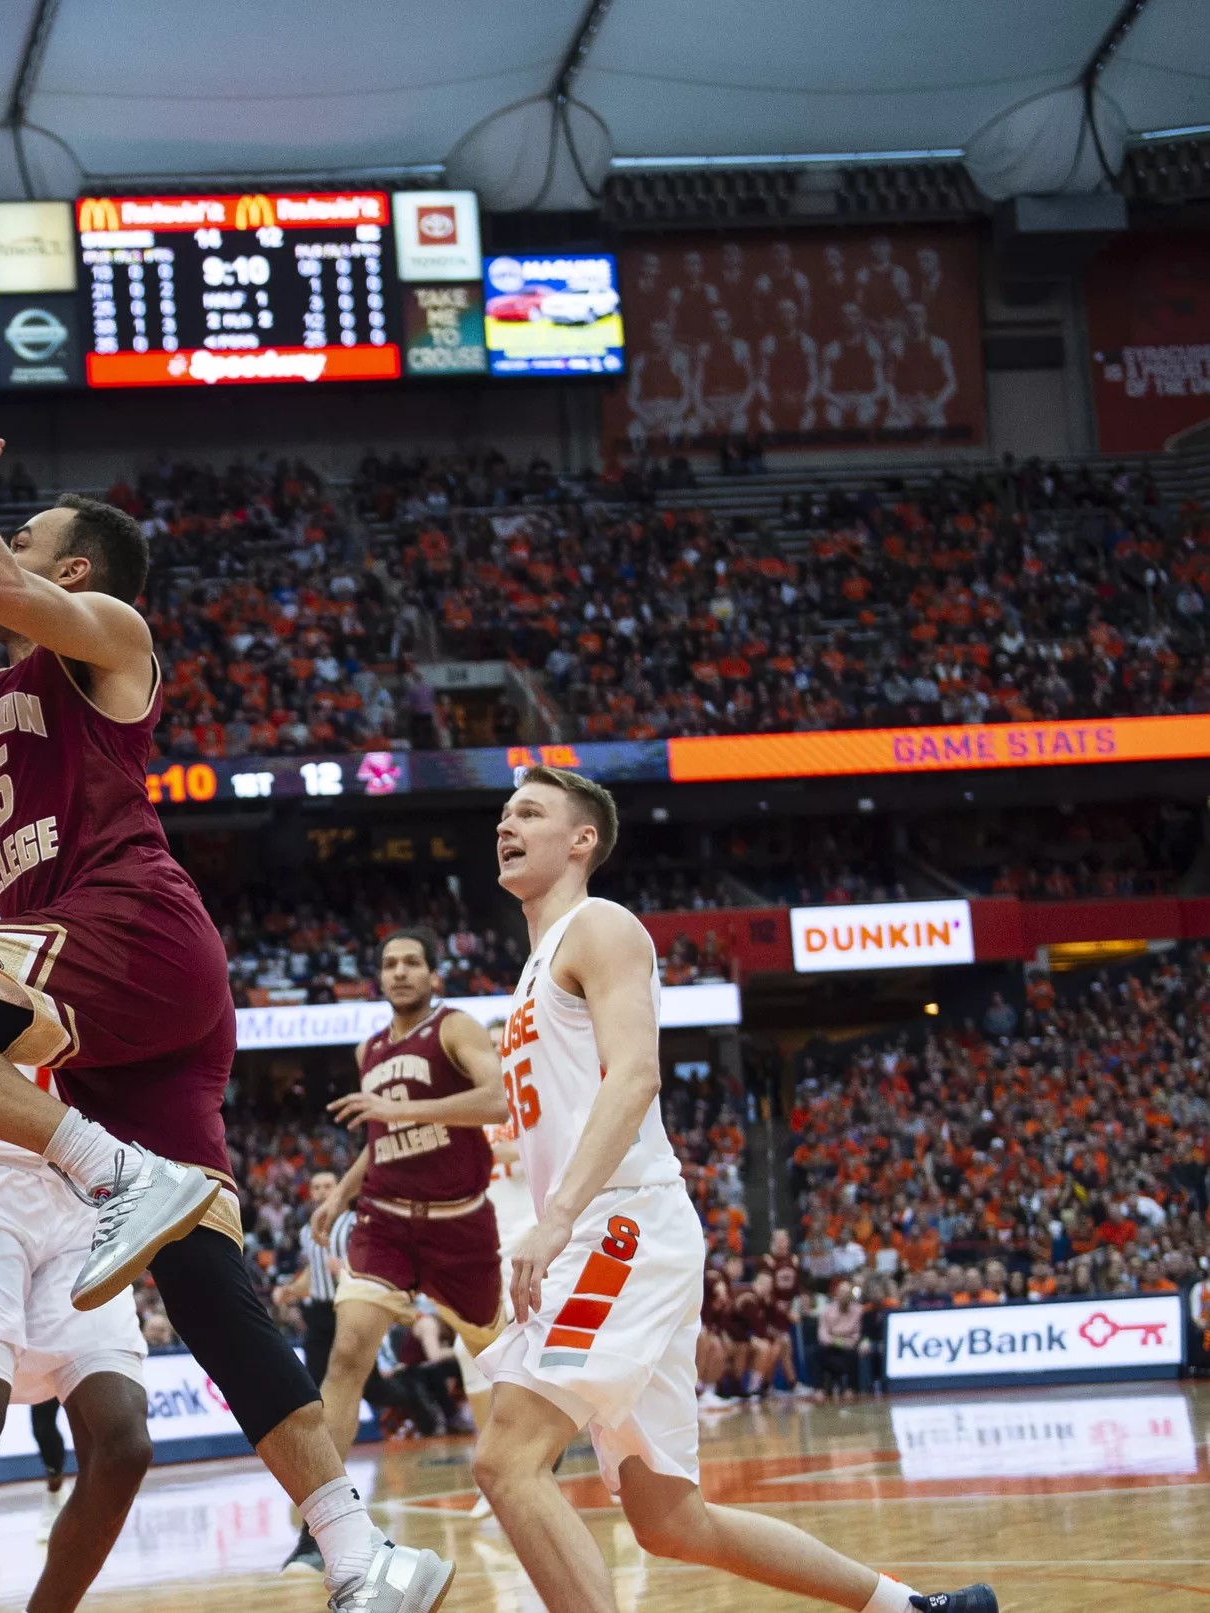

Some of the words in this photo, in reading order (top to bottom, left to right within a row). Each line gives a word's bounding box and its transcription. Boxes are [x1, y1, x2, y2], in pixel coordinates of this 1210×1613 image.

[202, 255, 270, 286] 9:10
[429, 328, 458, 346] TO
[892, 731, 997, 764] GAME
[1006, 726, 1115, 757] STATS
[300, 761, 343, 796] 12
[804, 919, 960, 953] DUNKIN'
[503, 1057, 542, 1140] 35
[374, 1123, 451, 1165] COLLEGE
[601, 1214, 640, 1262] S
[897, 1324, 1068, 1362] KeyBank
